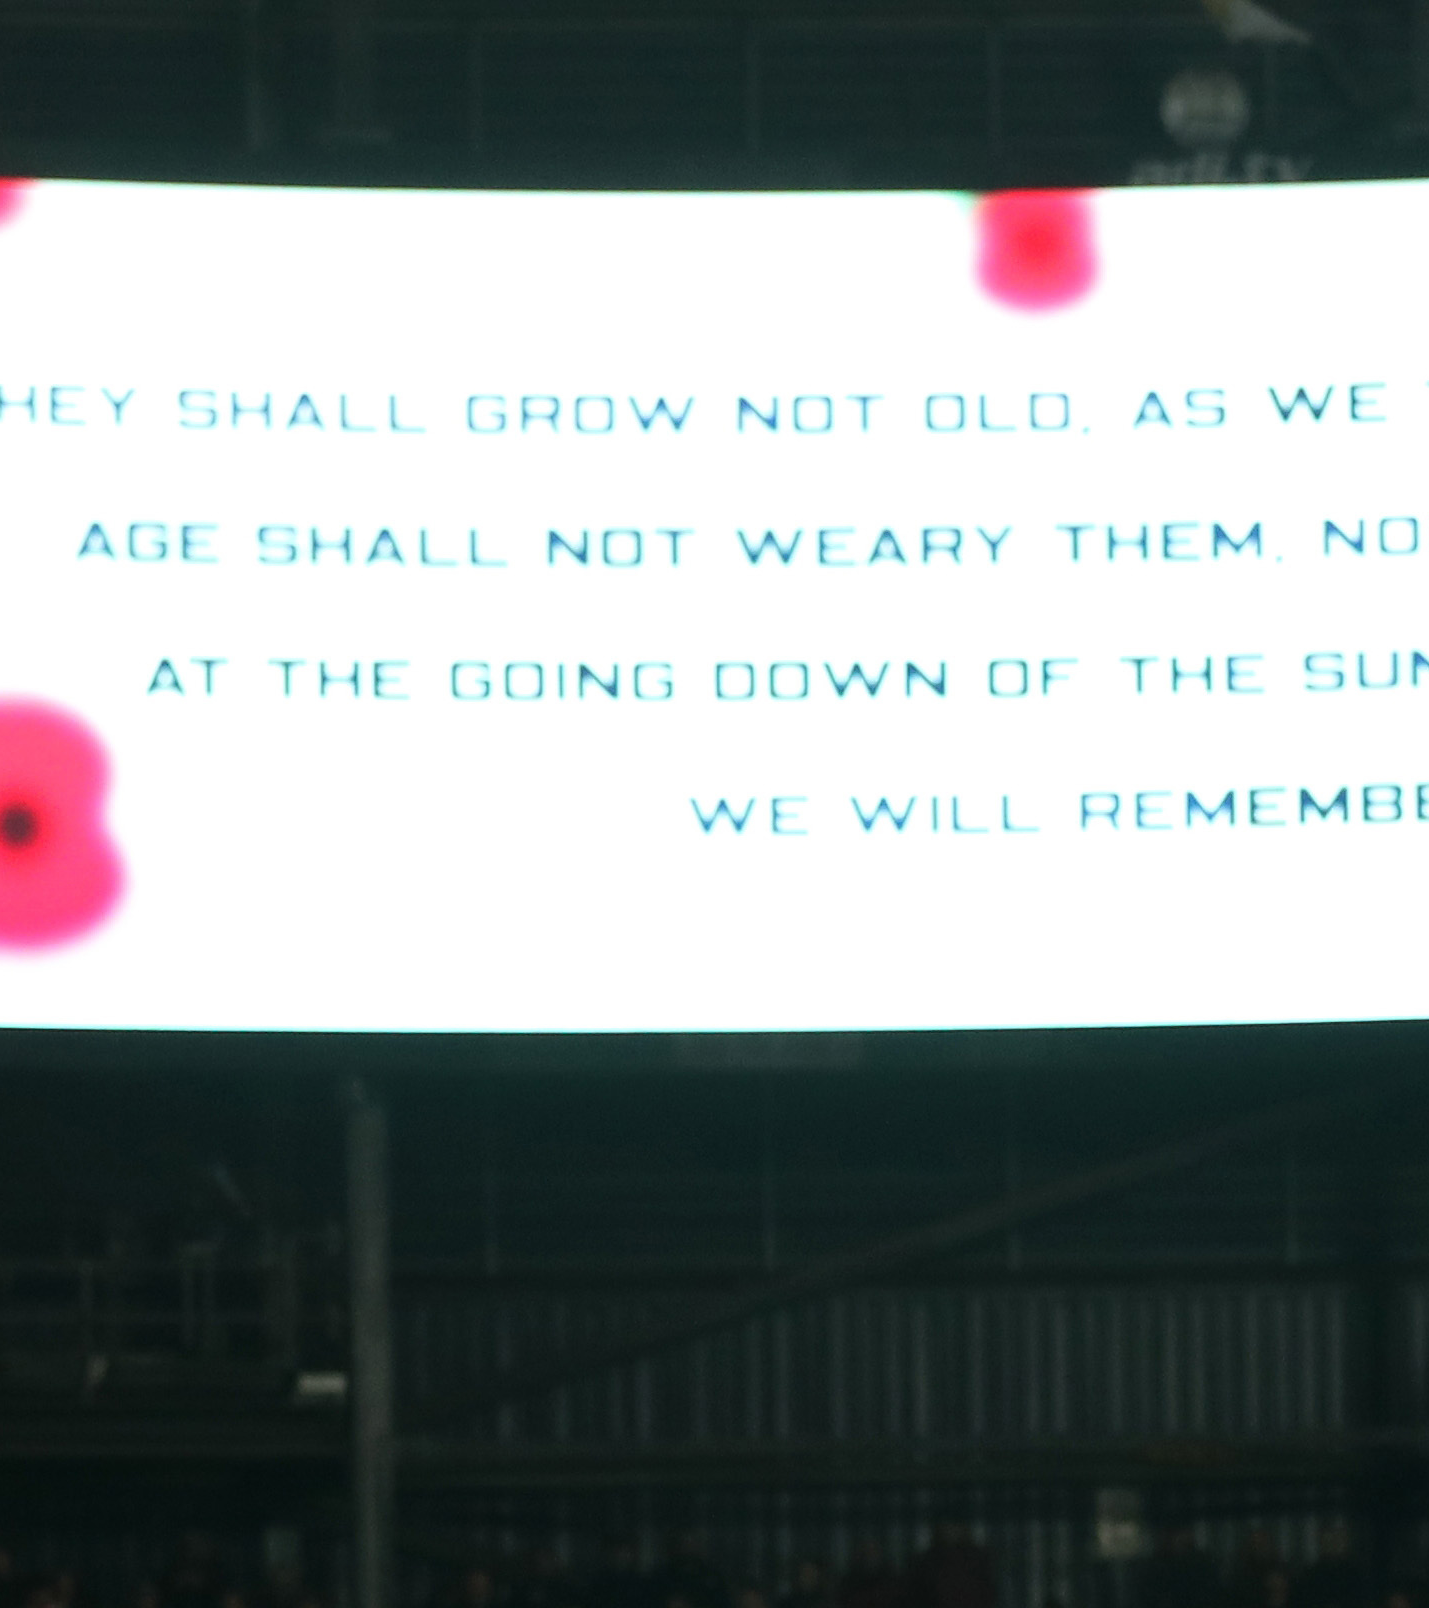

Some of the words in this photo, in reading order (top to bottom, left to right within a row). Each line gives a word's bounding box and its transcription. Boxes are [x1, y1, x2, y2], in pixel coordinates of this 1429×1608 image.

[177, 389, 427, 433] SHALL
[465, 395, 696, 434] GROW
[735, 394, 884, 434] NOT
[1132, 388, 1228, 429] AS
[1266, 381, 1387, 424] WE
[76, 521, 220, 563] AGE
[255, 525, 508, 567] SHALL
[545, 528, 695, 568] NOT
[734, 525, 1013, 567] WEARY
[145, 657, 229, 697] AT
[267, 659, 410, 700] THE
[449, 661, 675, 701] GOING
[713, 660, 949, 701] DOWN
[986, 657, 1079, 698] OF
[1119, 654, 1265, 695] THE
[689, 796, 808, 835] WE
[849, 794, 1040, 833] WILL
